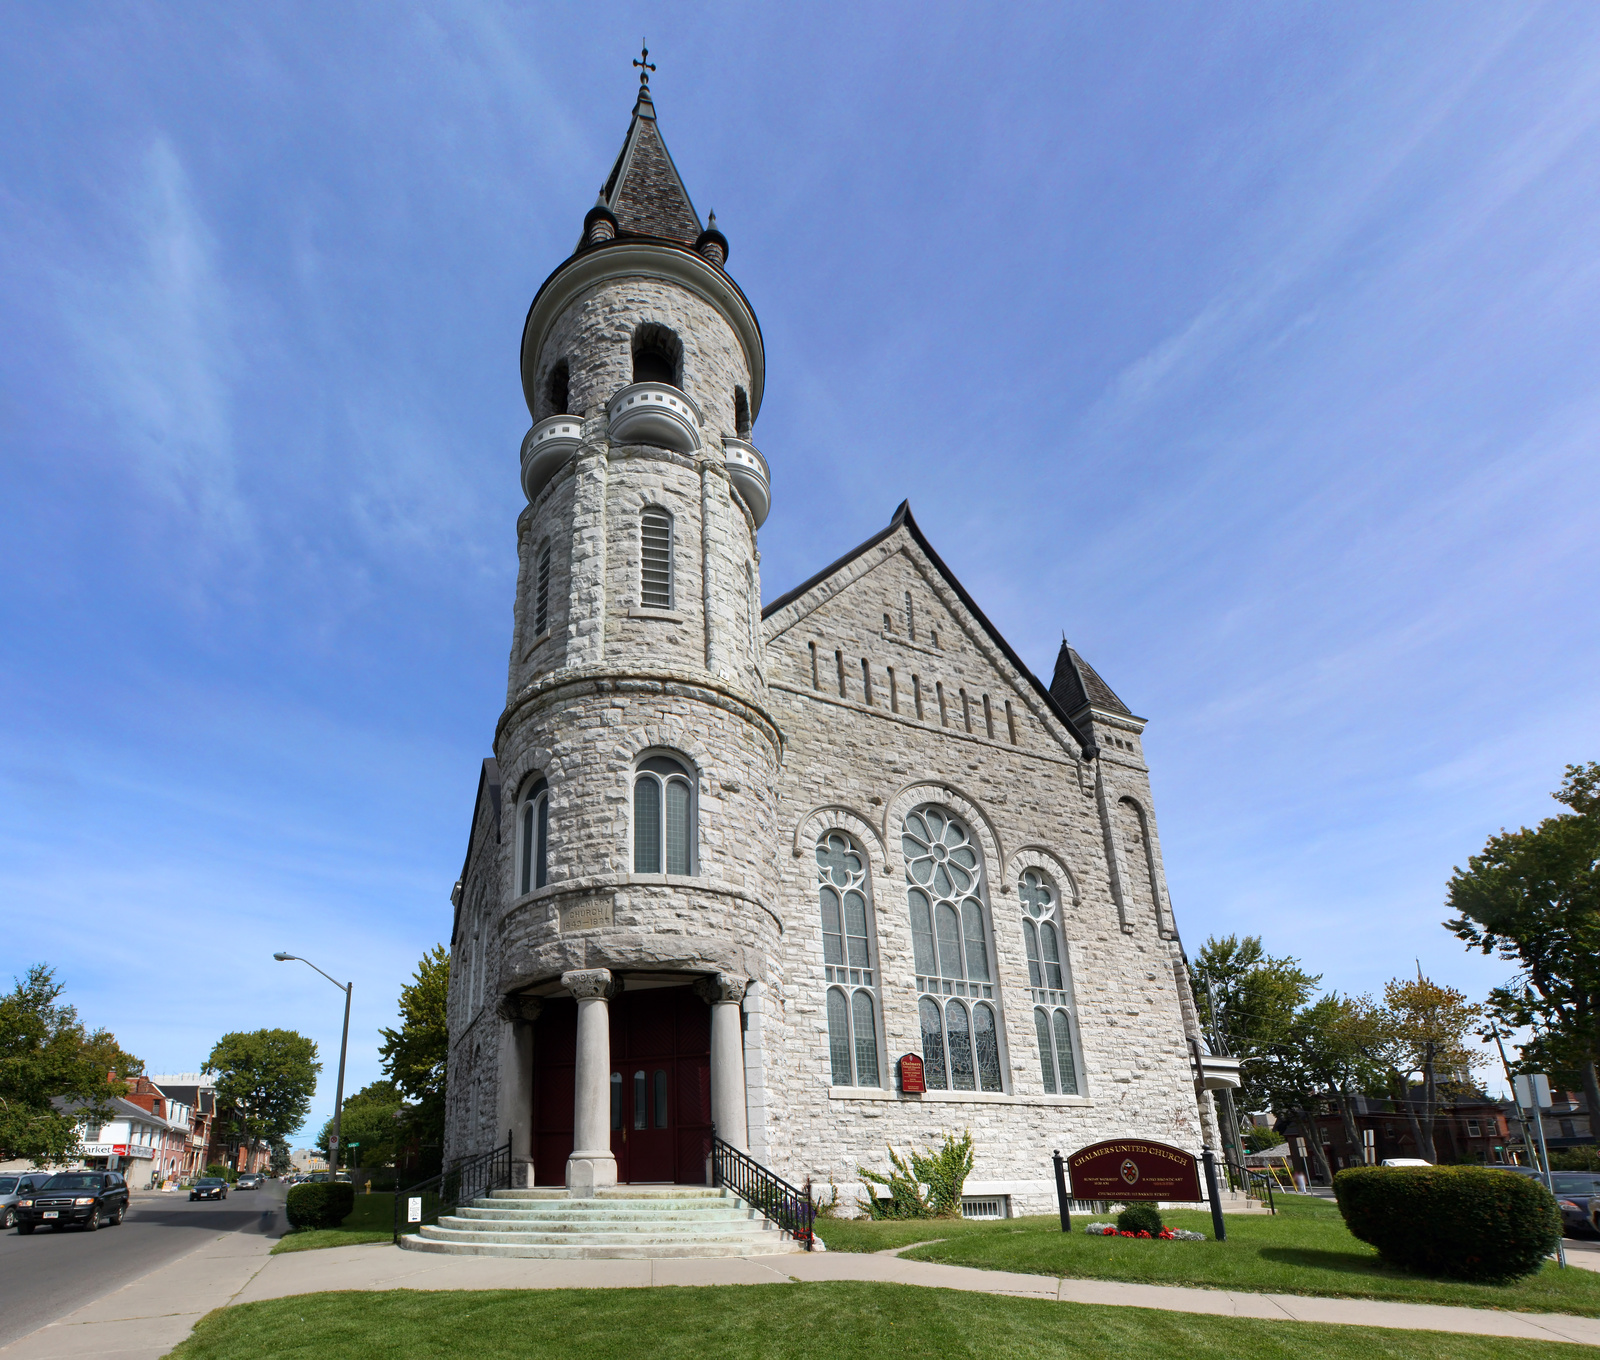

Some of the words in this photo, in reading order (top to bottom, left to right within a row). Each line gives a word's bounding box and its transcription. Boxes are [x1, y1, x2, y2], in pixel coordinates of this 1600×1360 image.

[562, 898, 610, 911] CHALMERS
[569, 908, 603, 919] CHURCH
[1074, 1145, 1115, 1167] CHALMERS
[1114, 1145, 1148, 1153] UNITED
[1148, 1147, 1188, 1167] CHURCH
